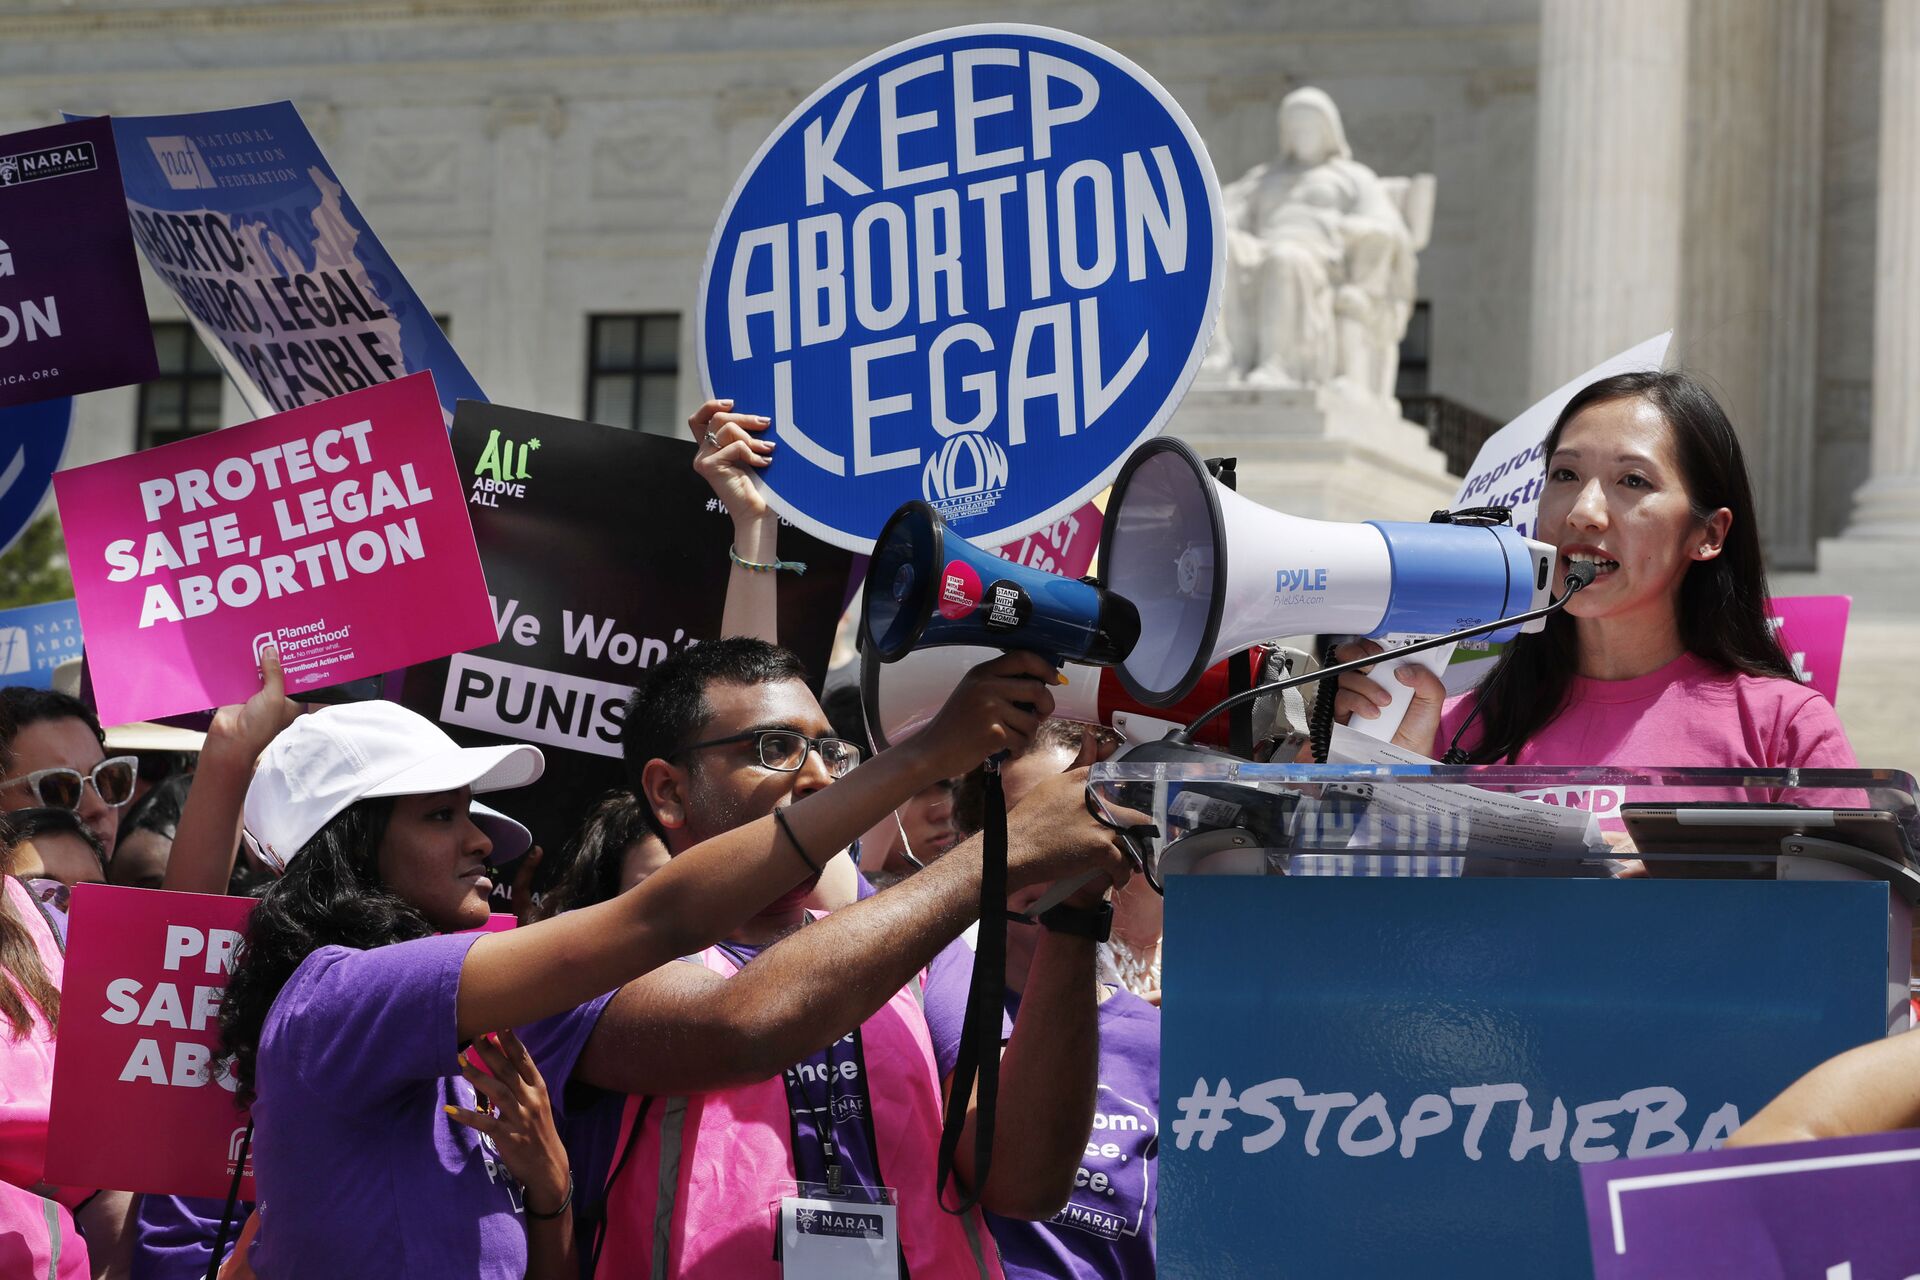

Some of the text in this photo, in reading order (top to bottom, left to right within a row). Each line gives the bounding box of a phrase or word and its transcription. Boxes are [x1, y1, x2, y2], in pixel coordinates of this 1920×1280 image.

[803, 48, 1100, 206] KEEP
[196, 129, 274, 148] NATIONAL
[23, 148, 88, 171] NARAL
[209, 148, 286, 168] ABORTION
[218, 168, 298, 189] FEDERATION
[728, 145, 1188, 361] ABORTION
[254, 269, 388, 331] LEGAL
[0, 368, 59, 386] ICA.ORG
[773, 296, 1149, 476] LEGAL
[139, 420, 373, 522] PROTECT
[922, 433, 1008, 502] NOW
[472, 477, 526, 498] ABOVE
[469, 490, 499, 508] ALL
[931, 491, 1001, 509] NATIONAL
[104, 462, 433, 583] SAFE, LEGAL
[138, 517, 425, 629] ABORTION
[1276, 568, 1327, 592] PYLE
[944, 595, 973, 606] PARENTHOOD
[996, 596, 1014, 606] WITH
[997, 587, 1018, 598] STAND
[991, 613, 1019, 624] WOMEN
[993, 605, 1015, 615] BLACK
[277, 618, 325, 640] Planned
[306, 647, 325, 656] matter
[284, 652, 355, 674] Parenthood Action Fund
[822, 1214, 878, 1230] NARAL
[1070, 1207, 1119, 1231] NARAL
